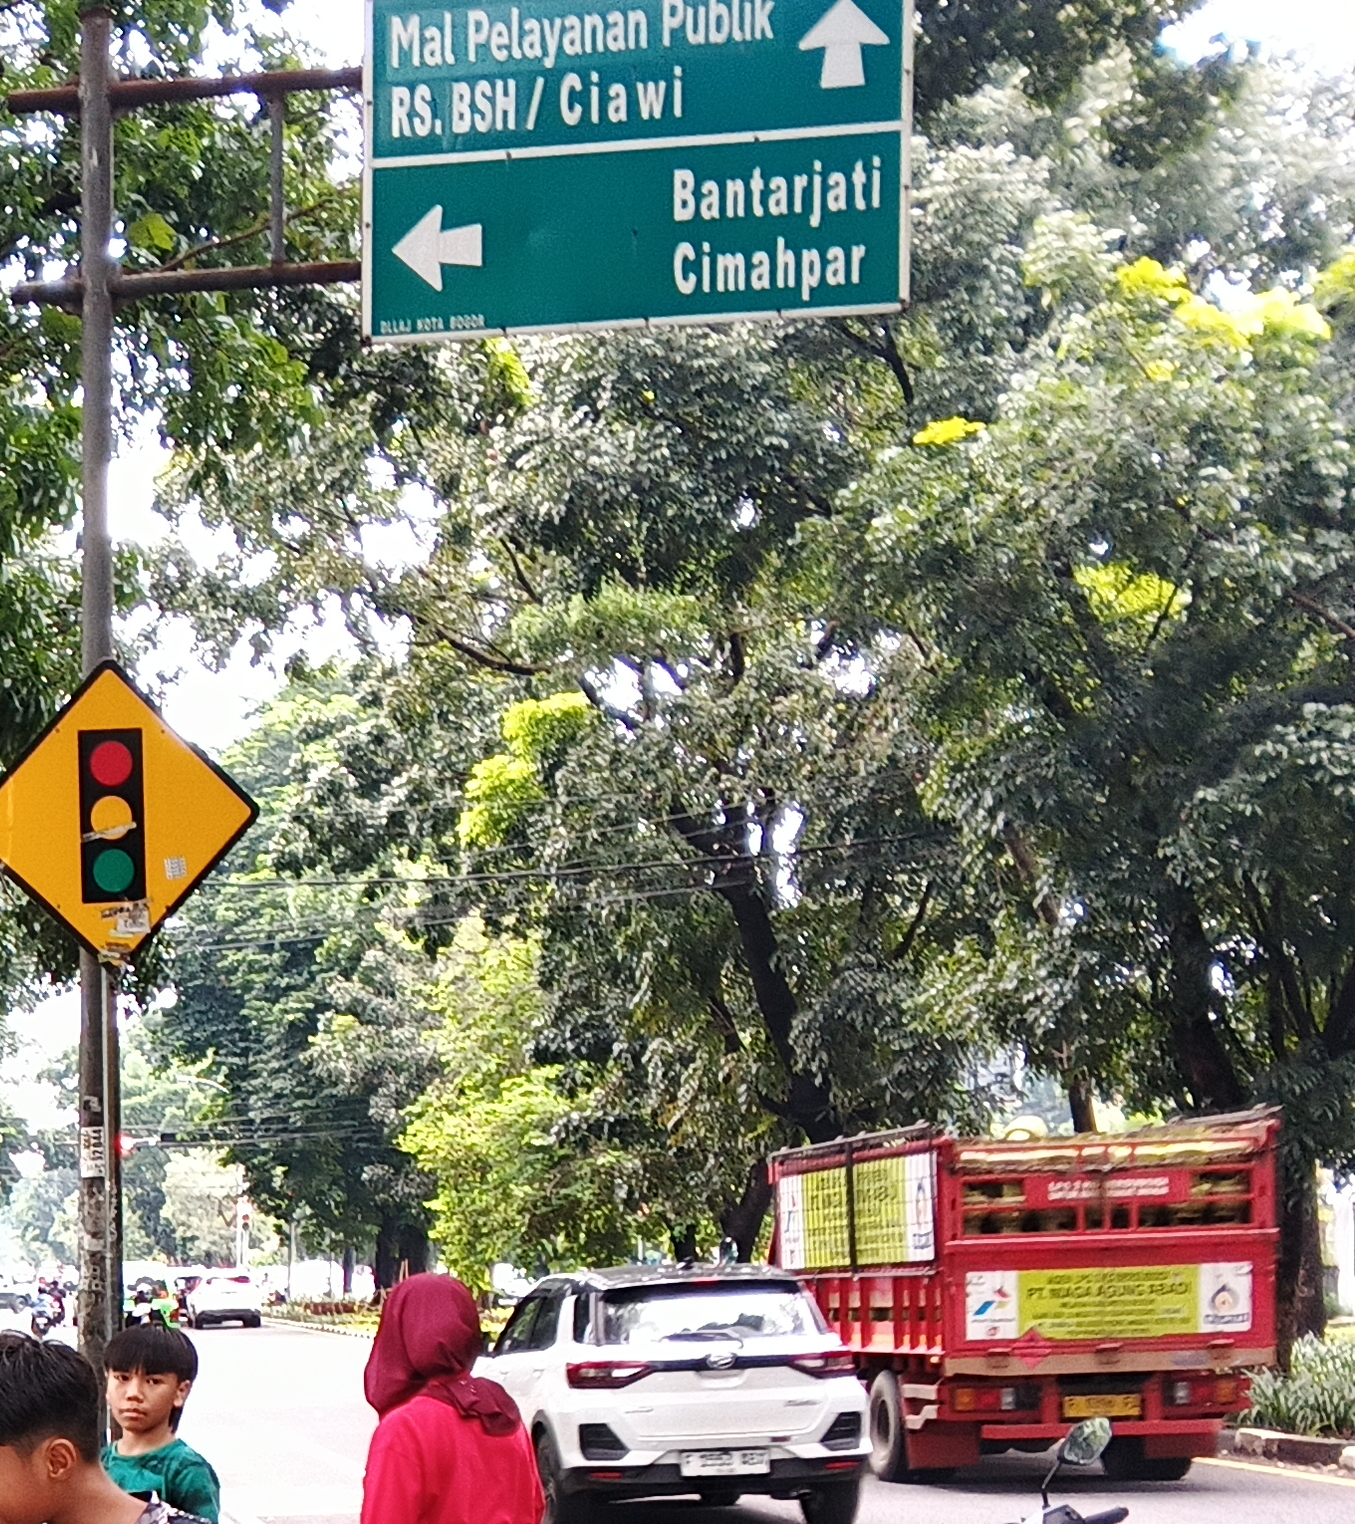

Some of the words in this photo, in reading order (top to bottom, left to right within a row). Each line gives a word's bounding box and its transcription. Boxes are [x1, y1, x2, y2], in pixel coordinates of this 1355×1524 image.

[391, 11, 455, 68] Mal
[467, 7, 648, 69] Pelayanan
[662, 0, 775, 47] Publik
[391, 83, 442, 138] RS.
[452, 79, 516, 134] BSH
[560, 65, 683, 126] Ciawi
[673, 155, 881, 228] Bantarjati
[673, 236, 866, 302] Cimahpar
